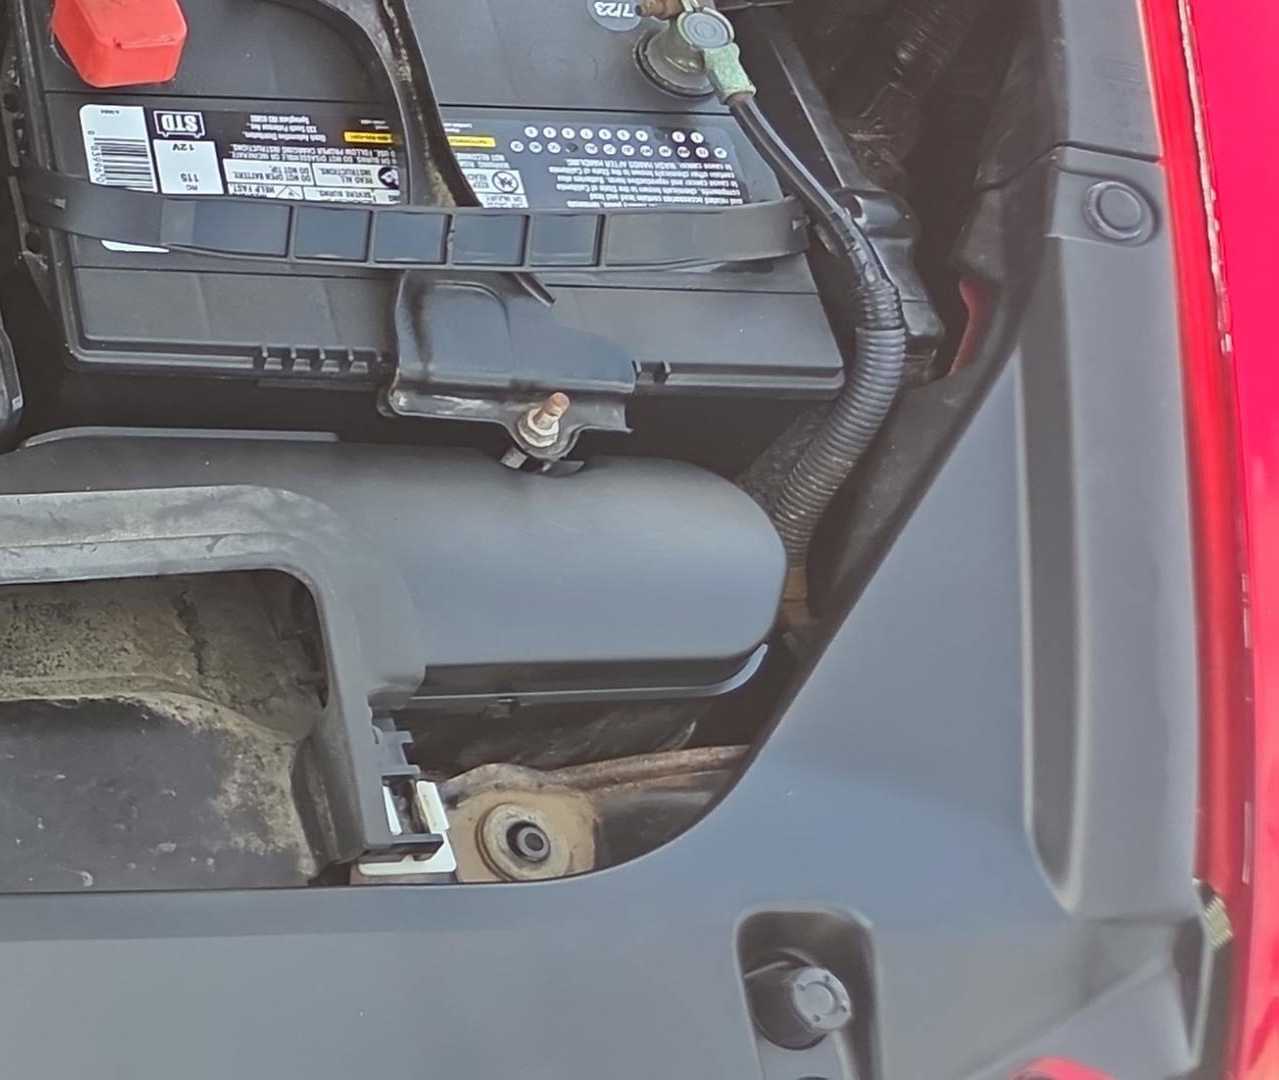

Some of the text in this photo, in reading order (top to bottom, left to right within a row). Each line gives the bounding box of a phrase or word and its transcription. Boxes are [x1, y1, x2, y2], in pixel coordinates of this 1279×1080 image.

[594, 1, 635, 18] 7/23
[161, 114, 198, 131] STD
[180, 173, 199, 182] 115
[230, 184, 252, 192] FAST.
